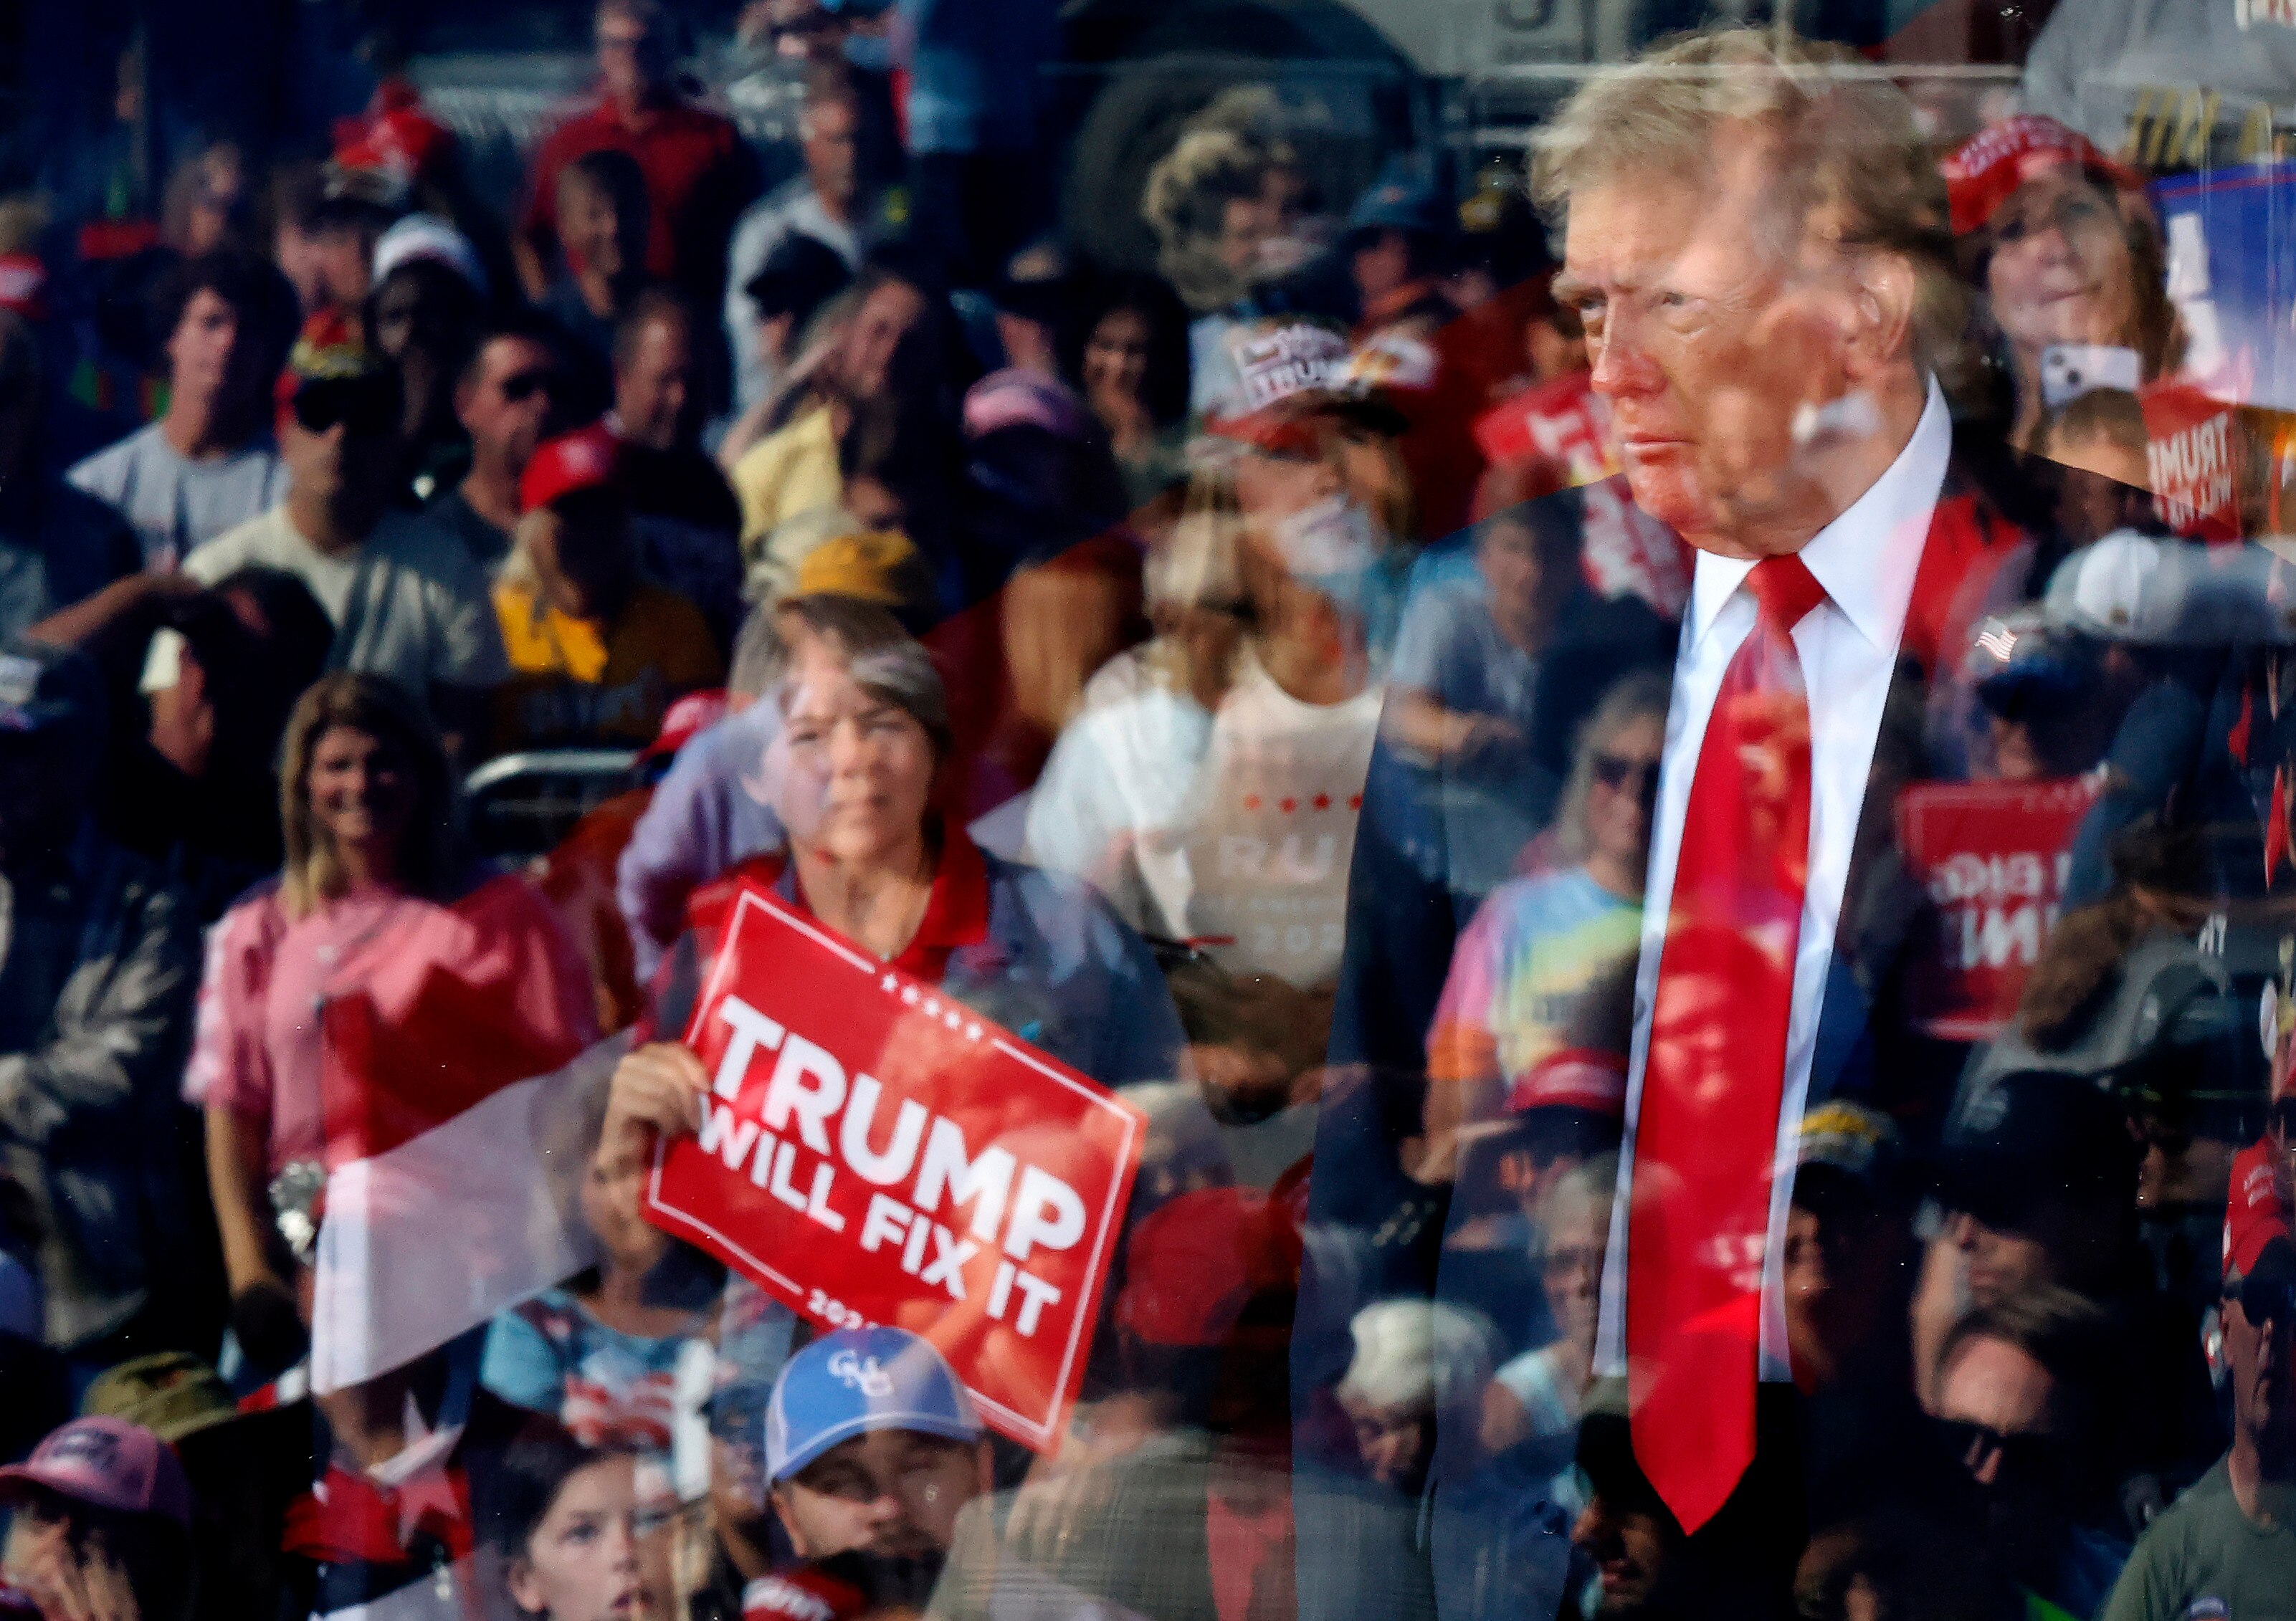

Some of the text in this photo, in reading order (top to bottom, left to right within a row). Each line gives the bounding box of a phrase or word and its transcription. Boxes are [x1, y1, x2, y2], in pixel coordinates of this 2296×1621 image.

[1252, 923, 1345, 954] 202
[713, 994, 1087, 1261] TRUMP
[697, 1094, 1061, 1338] WILL FIX IT
[806, 1287, 880, 1331] 202
